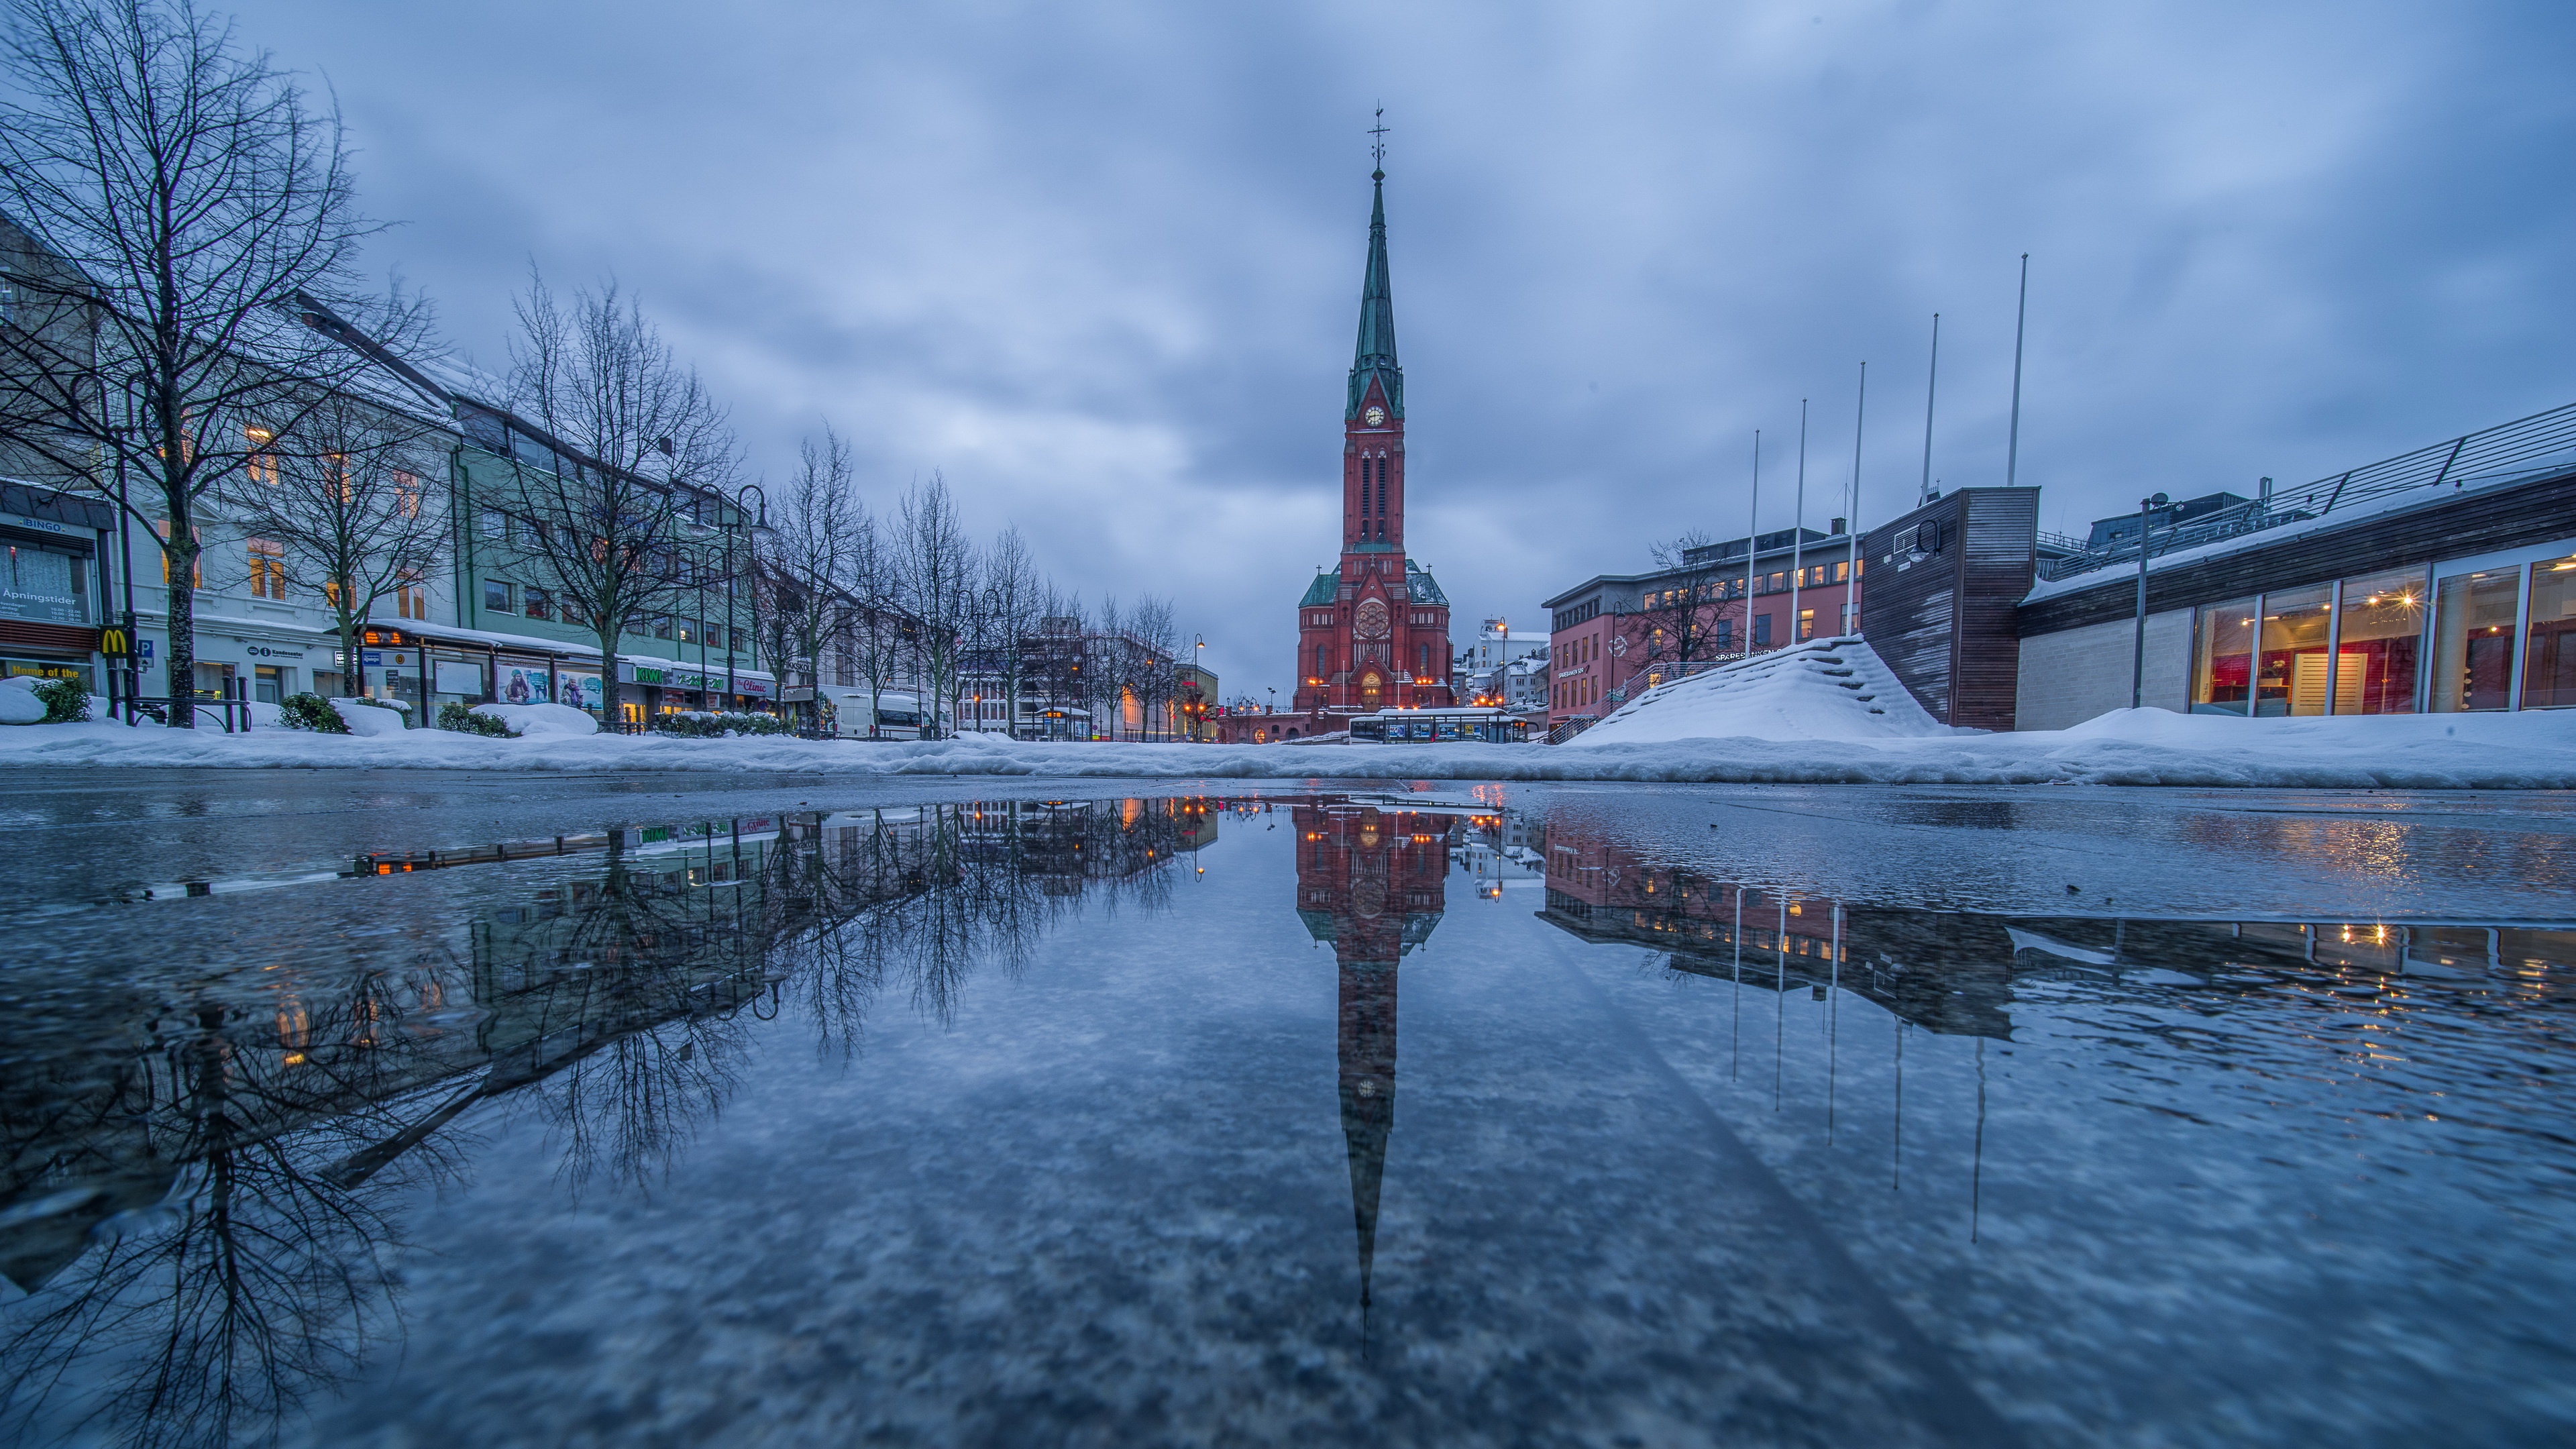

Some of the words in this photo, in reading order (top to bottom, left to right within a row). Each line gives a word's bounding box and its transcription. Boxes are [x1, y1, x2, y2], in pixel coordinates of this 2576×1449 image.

[25, 519, 61, 532] BINGO
[3, 588, 76, 605] Åpningstider
[142, 642, 150, 655] P
[12, 665, 44, 676] Home
[48, 668, 58, 677] of
[61, 669, 79, 678] the
[635, 666, 662, 684] KIWI
[743, 680, 767, 692] Clinic
